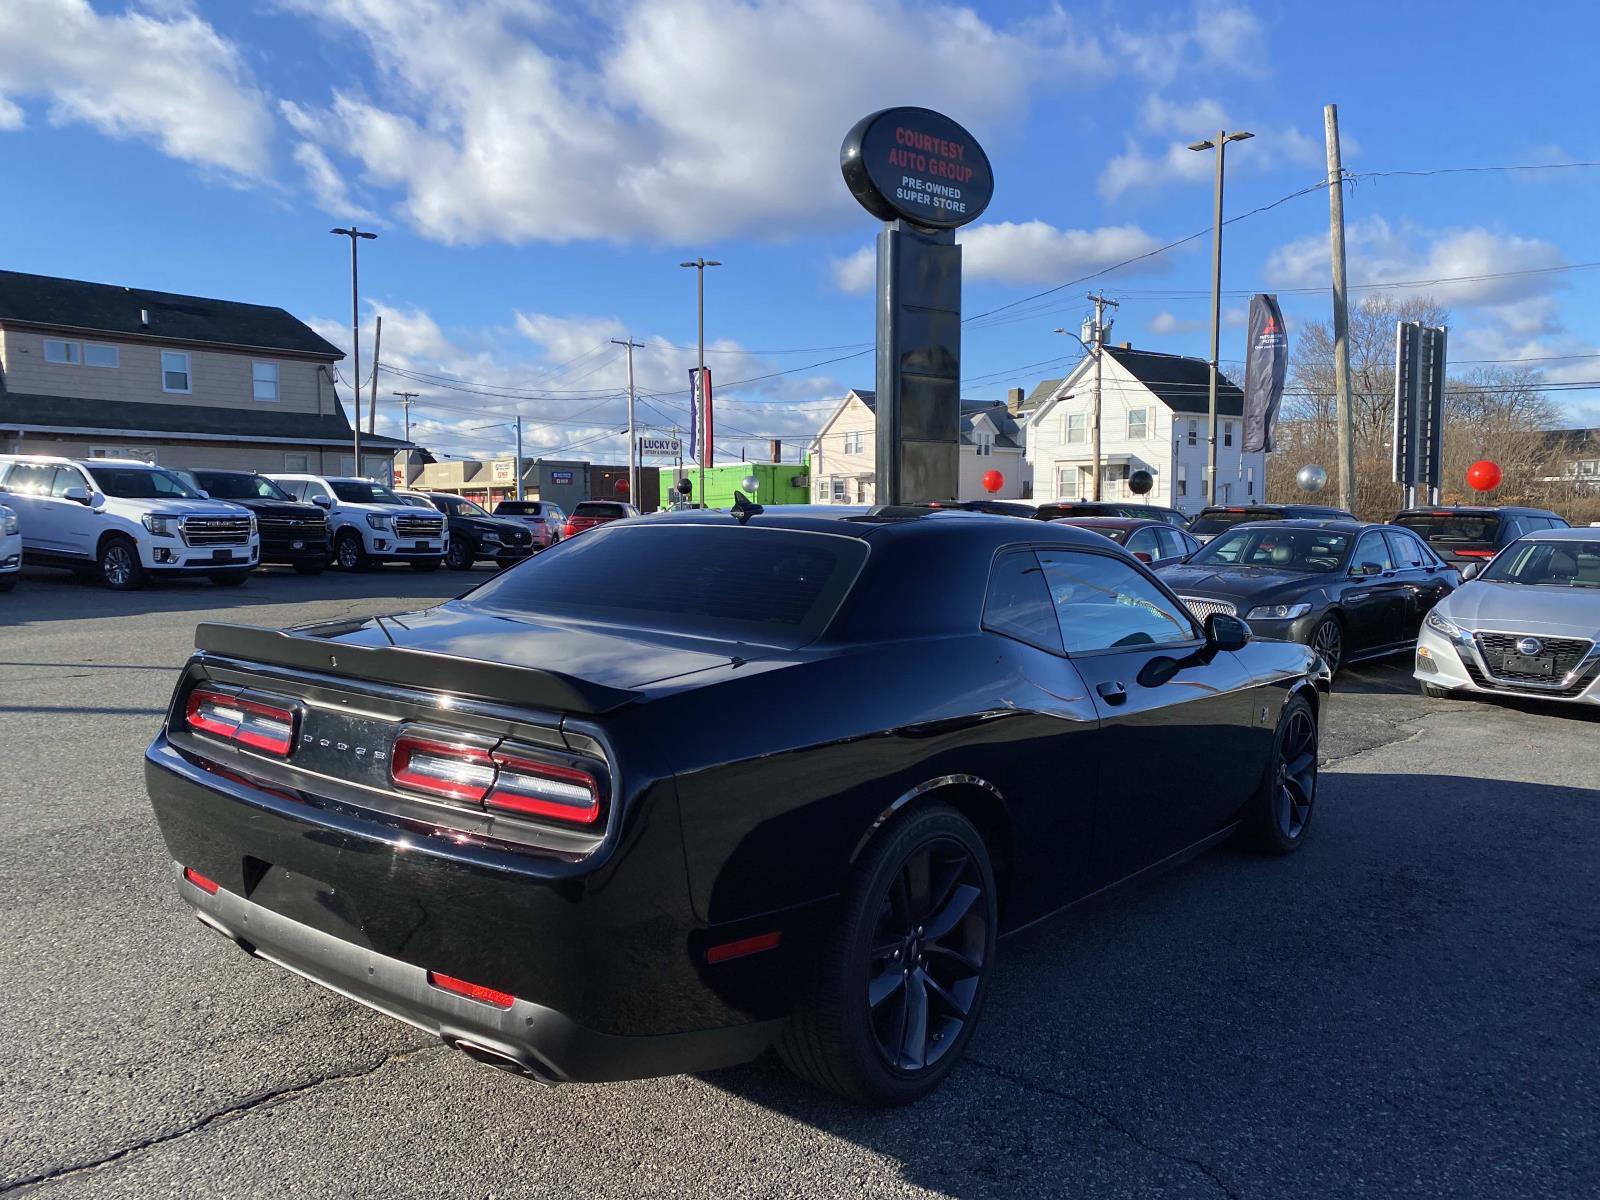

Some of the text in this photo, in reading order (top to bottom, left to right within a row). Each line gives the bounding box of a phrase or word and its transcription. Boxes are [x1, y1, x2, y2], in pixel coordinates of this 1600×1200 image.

[896, 127, 964, 160] COURTESY
[889, 148, 972, 183] AUTO GROUP
[902, 176, 961, 199] PRE-OWNED
[897, 188, 966, 213] SUPER STORE
[644, 440, 669, 449] LUCKY
[303, 734, 386, 759] DODGE
